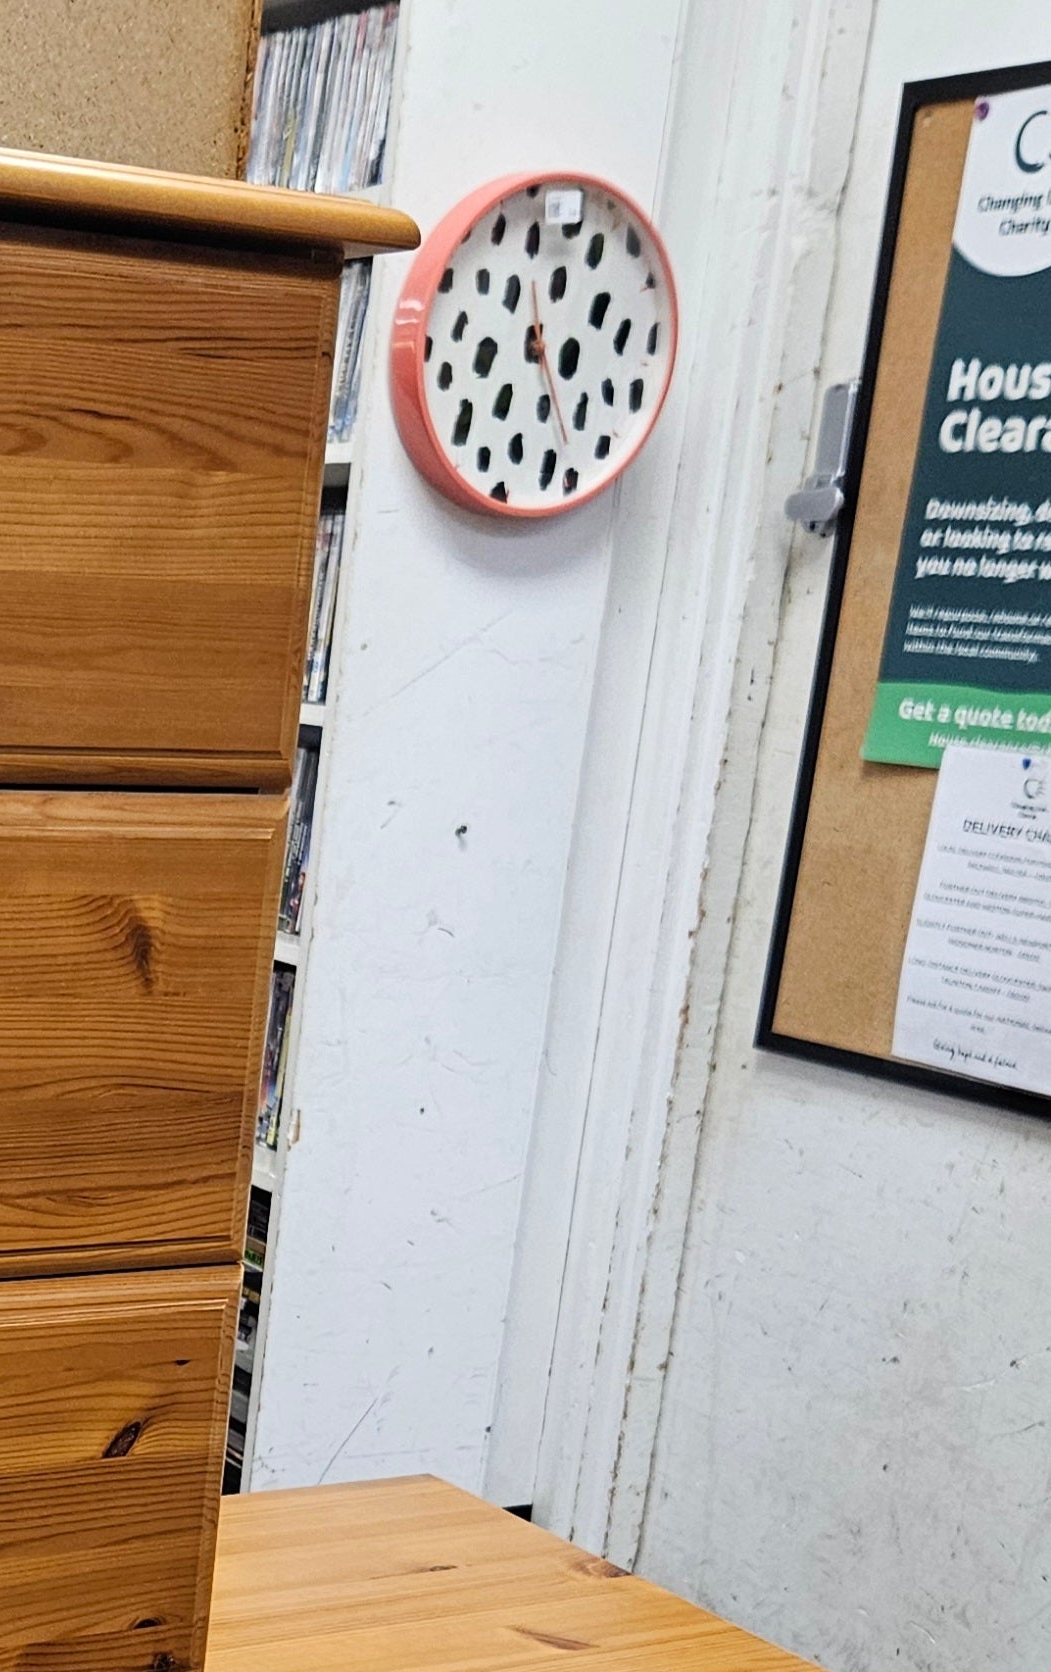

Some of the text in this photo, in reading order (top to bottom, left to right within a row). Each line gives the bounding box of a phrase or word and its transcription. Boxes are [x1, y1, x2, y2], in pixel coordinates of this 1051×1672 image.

[977, 194, 1044, 213] Changing
[998, 217, 1051, 236] Charity
[943, 524, 1012, 555] looking
[915, 556, 952, 579] you
[977, 553, 1039, 584] longer
[899, 697, 935, 722] Get
[937, 704, 952, 724] a
[954, 704, 1014, 730] quote
